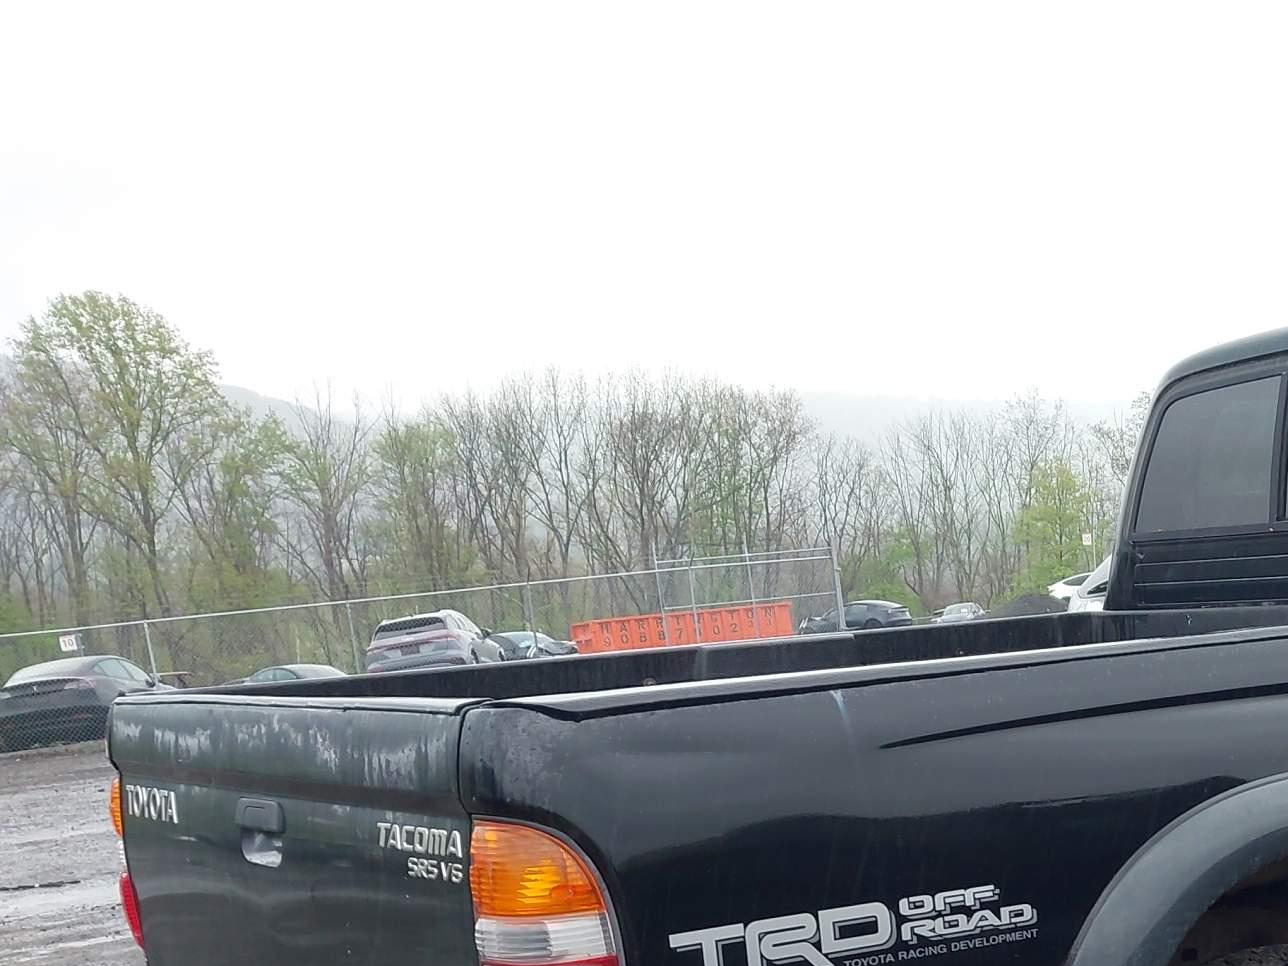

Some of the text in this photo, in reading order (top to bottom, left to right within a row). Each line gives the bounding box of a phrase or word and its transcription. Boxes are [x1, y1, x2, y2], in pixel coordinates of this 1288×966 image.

[125, 784, 179, 825] TOYOTA
[376, 822, 464, 859] TACOMA
[407, 856, 464, 885] SR5 V6
[899, 884, 1000, 919] OFF
[900, 903, 1039, 945] ROAD
[897, 943, 949, 962] RACING
[950, 928, 1040, 951] DEVELOPMENT
